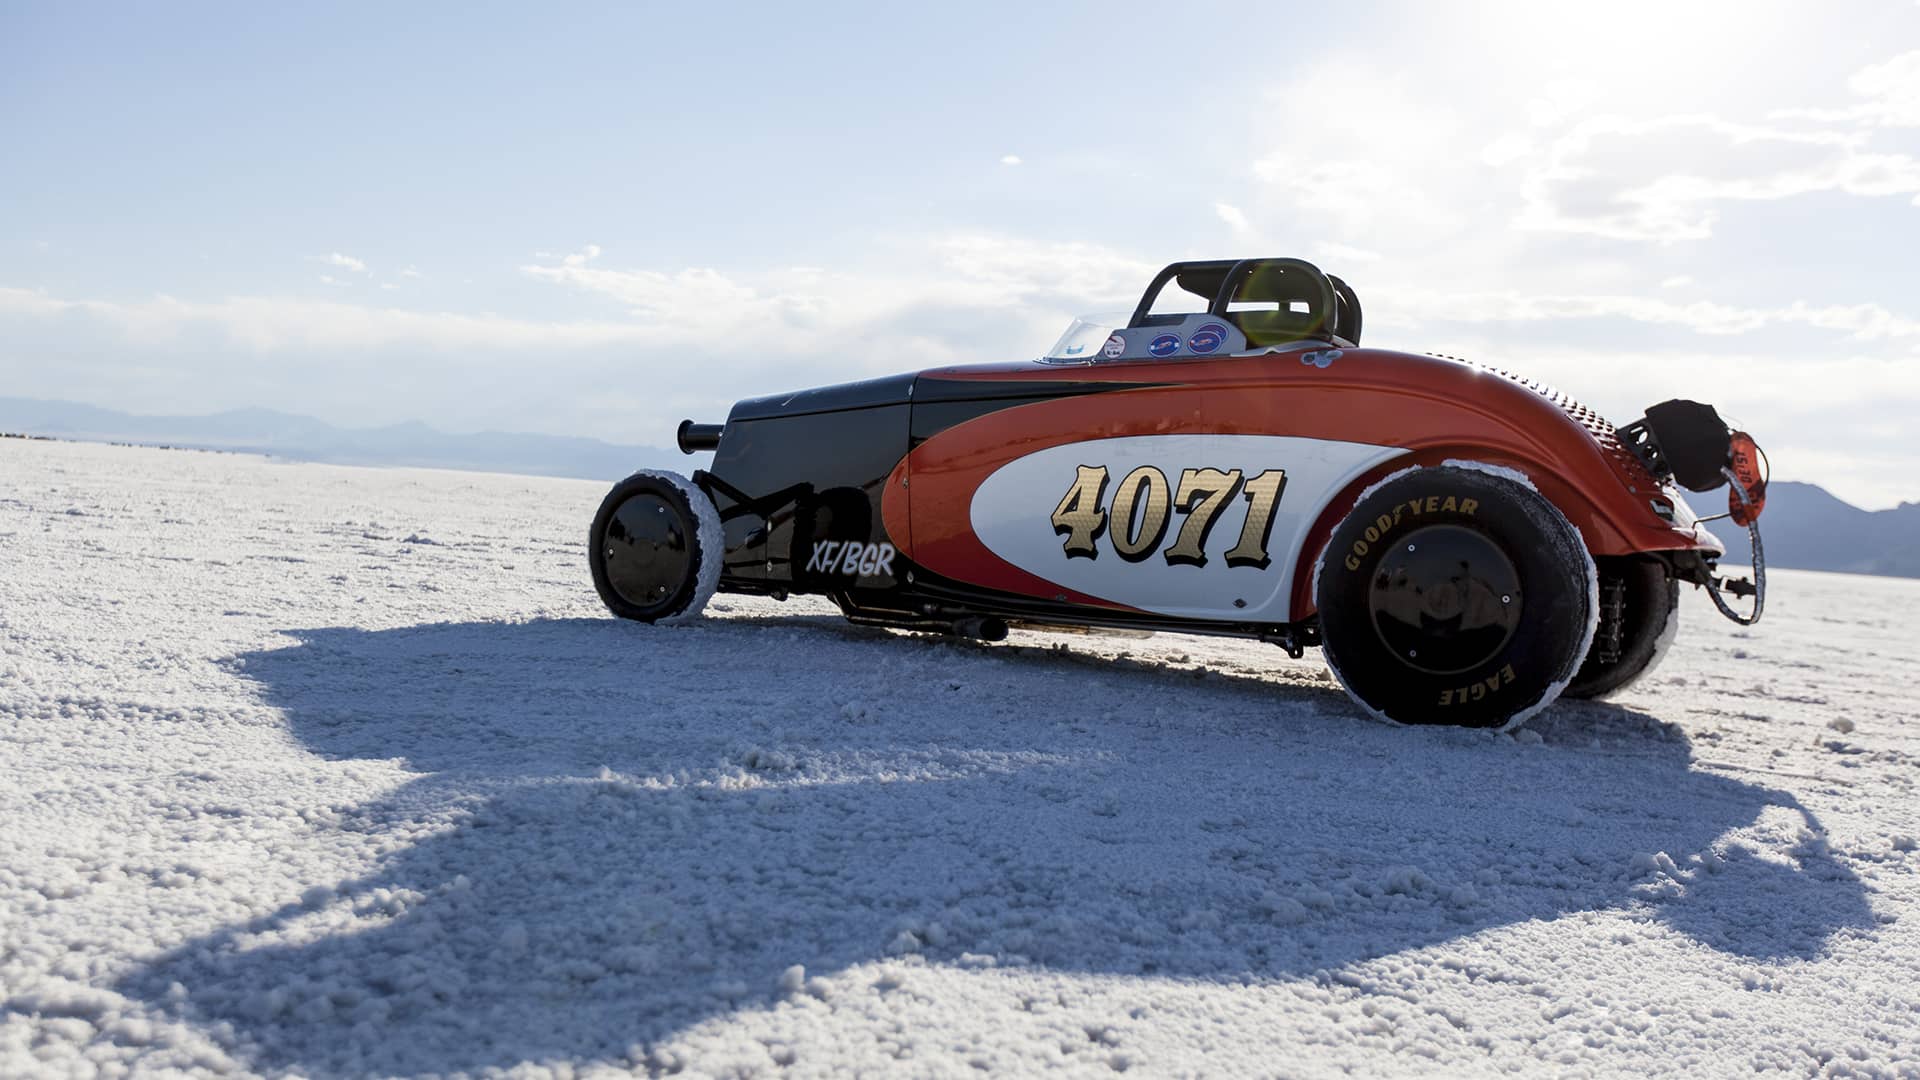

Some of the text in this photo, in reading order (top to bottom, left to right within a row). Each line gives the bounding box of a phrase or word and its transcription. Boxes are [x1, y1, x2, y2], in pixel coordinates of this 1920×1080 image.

[1050, 464, 1288, 570] 4071
[1345, 496, 1478, 571] GOODYEAR
[805, 539, 896, 577] XF/BGR
[1438, 663, 1516, 706] EAGLE
